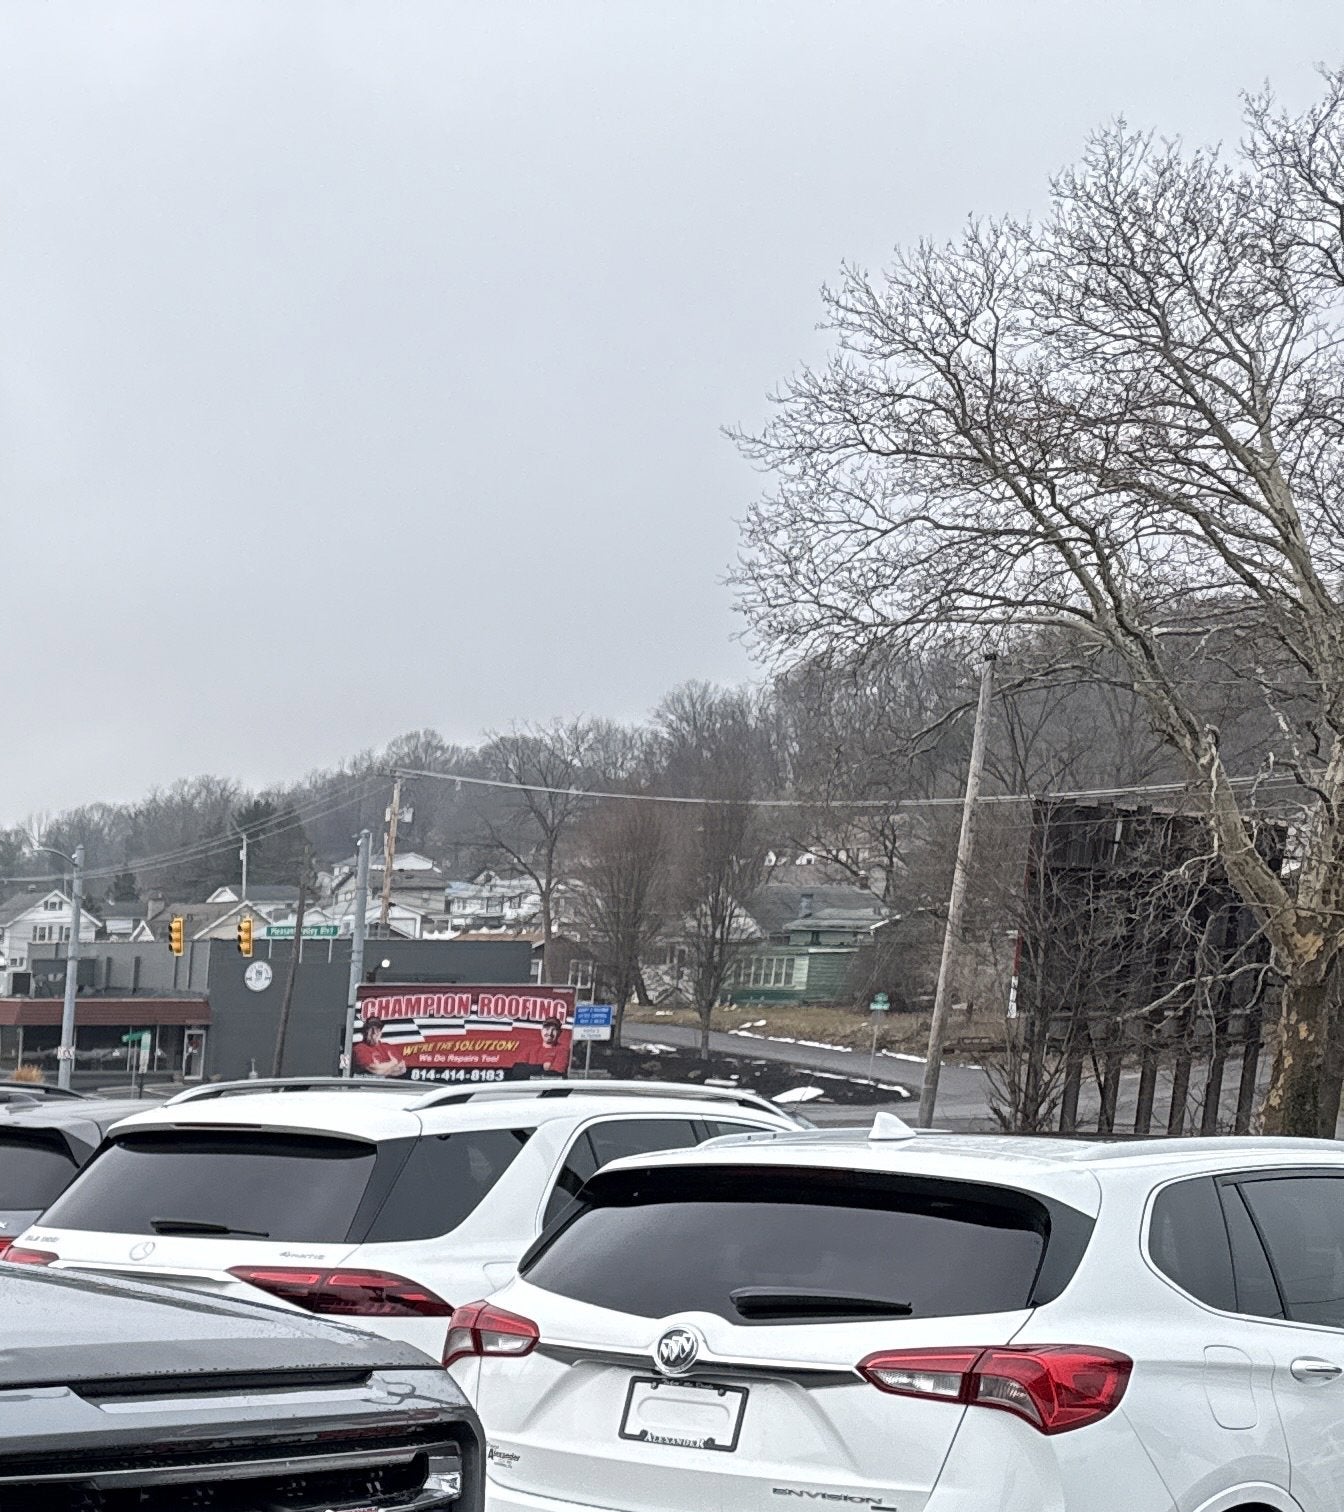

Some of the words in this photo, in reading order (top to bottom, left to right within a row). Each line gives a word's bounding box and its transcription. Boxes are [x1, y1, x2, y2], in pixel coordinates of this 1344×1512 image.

[362, 993, 472, 1021] CHAMPION
[478, 994, 567, 1024] ROOFING
[402, 1042, 434, 1056] WE'RE
[435, 1041, 454, 1051] THE
[453, 1040, 520, 1051] SOLUTION!
[419, 1054, 432, 1062] We
[434, 1054, 446, 1062] Do
[447, 1054, 479, 1063] Repairs
[481, 1054, 500, 1062] Too!
[772, 1487, 883, 1505] ENVISION
